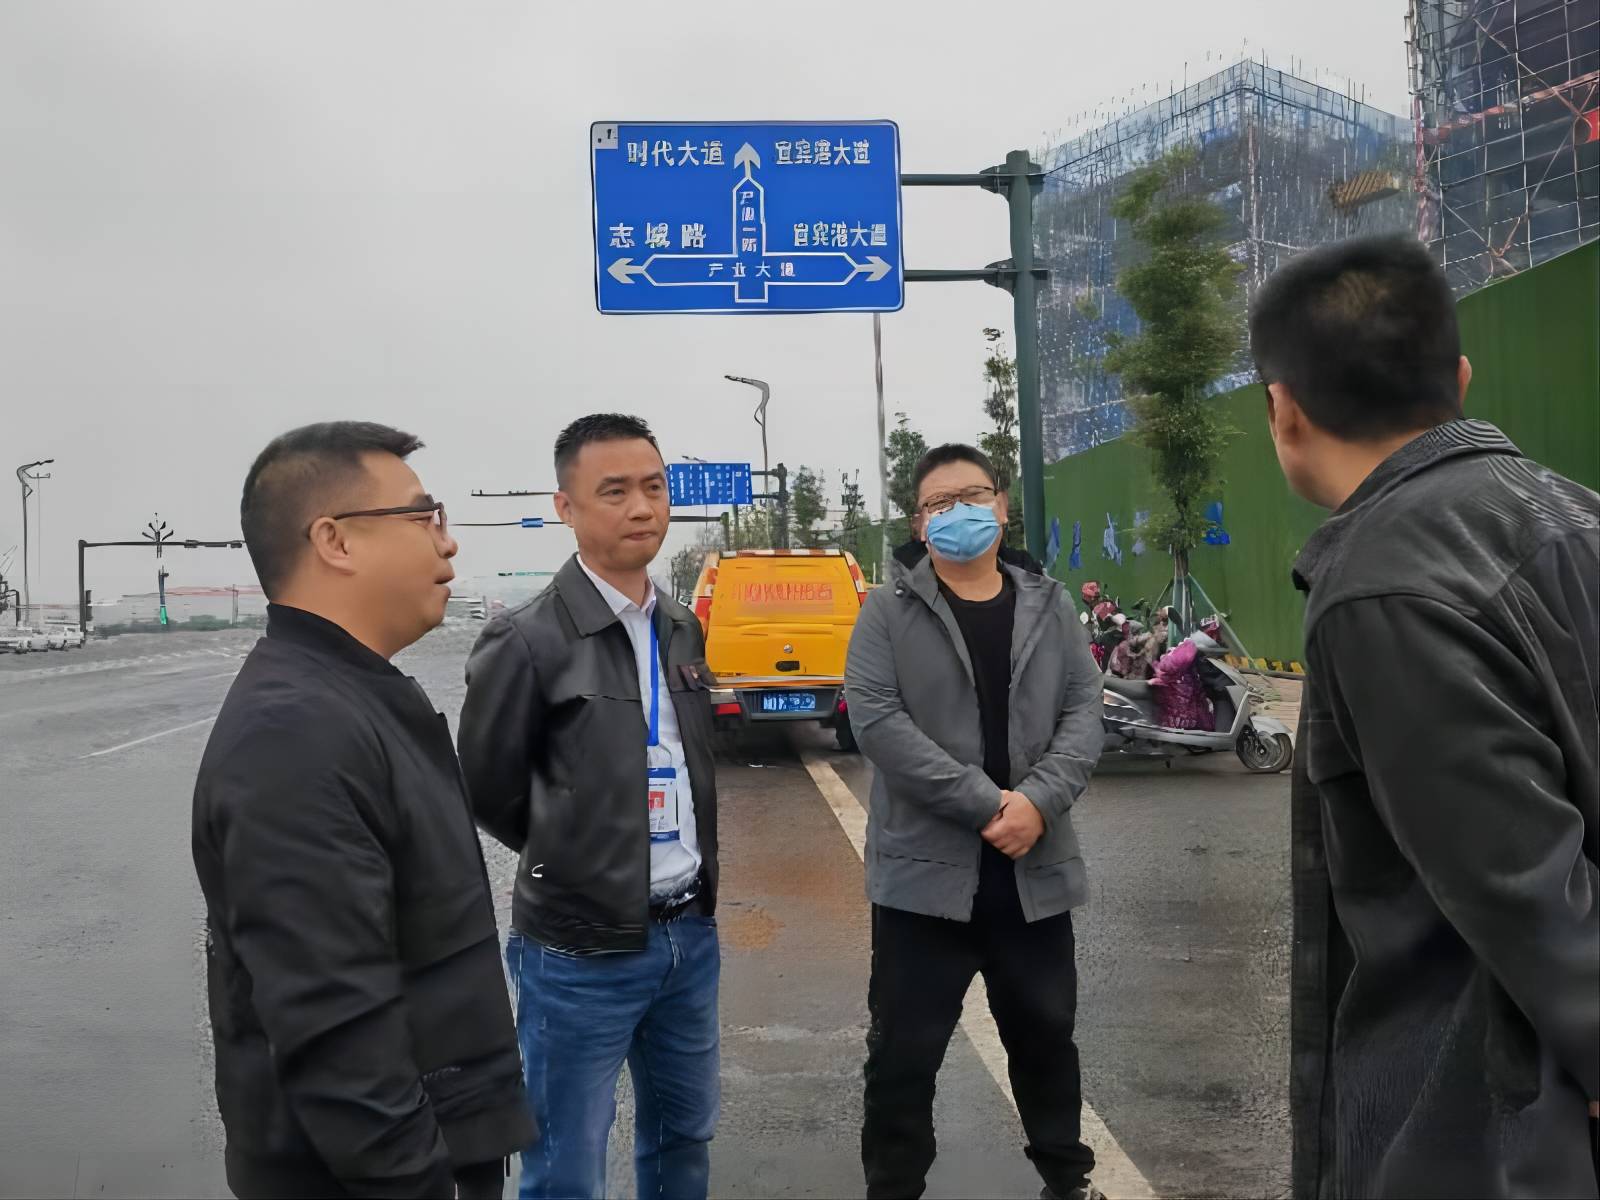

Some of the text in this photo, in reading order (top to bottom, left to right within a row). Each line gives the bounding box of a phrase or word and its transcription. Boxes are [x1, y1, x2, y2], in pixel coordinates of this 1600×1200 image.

[627, 140, 725, 166] 时代大道
[708, 261, 796, 277] 产业大道
